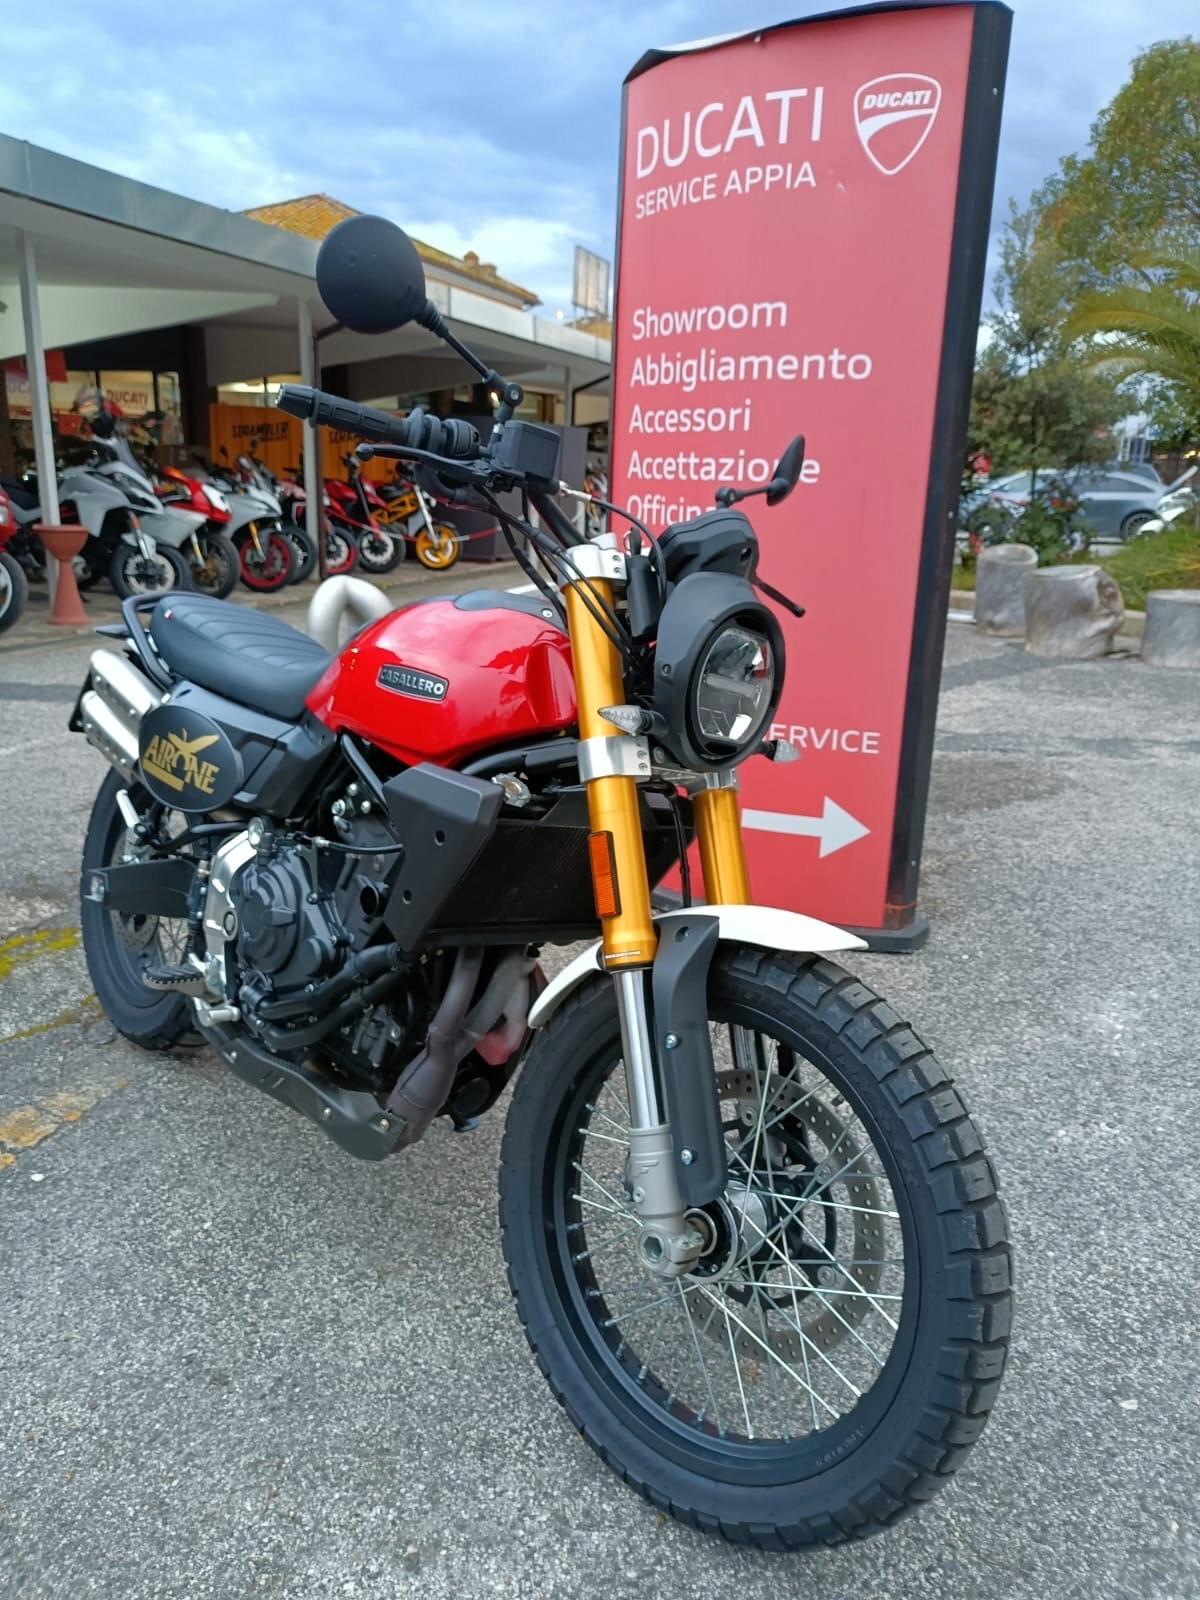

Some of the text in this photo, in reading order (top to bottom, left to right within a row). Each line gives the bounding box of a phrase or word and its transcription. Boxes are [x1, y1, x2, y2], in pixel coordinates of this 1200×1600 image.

[863, 90, 931, 110] DUCATI
[636, 86, 824, 179] DUCATI
[635, 161, 817, 219] SERVICE APPIA
[631, 300, 788, 341] Showroom
[630, 348, 873, 393] Abbigliamento
[106, 389, 149, 407] DUCATI
[628, 398, 751, 434] Accessori
[627, 449, 821, 484] Accettazioe
[381, 669, 445, 695] CABALLERO
[762, 723, 881, 755] ERVICE
